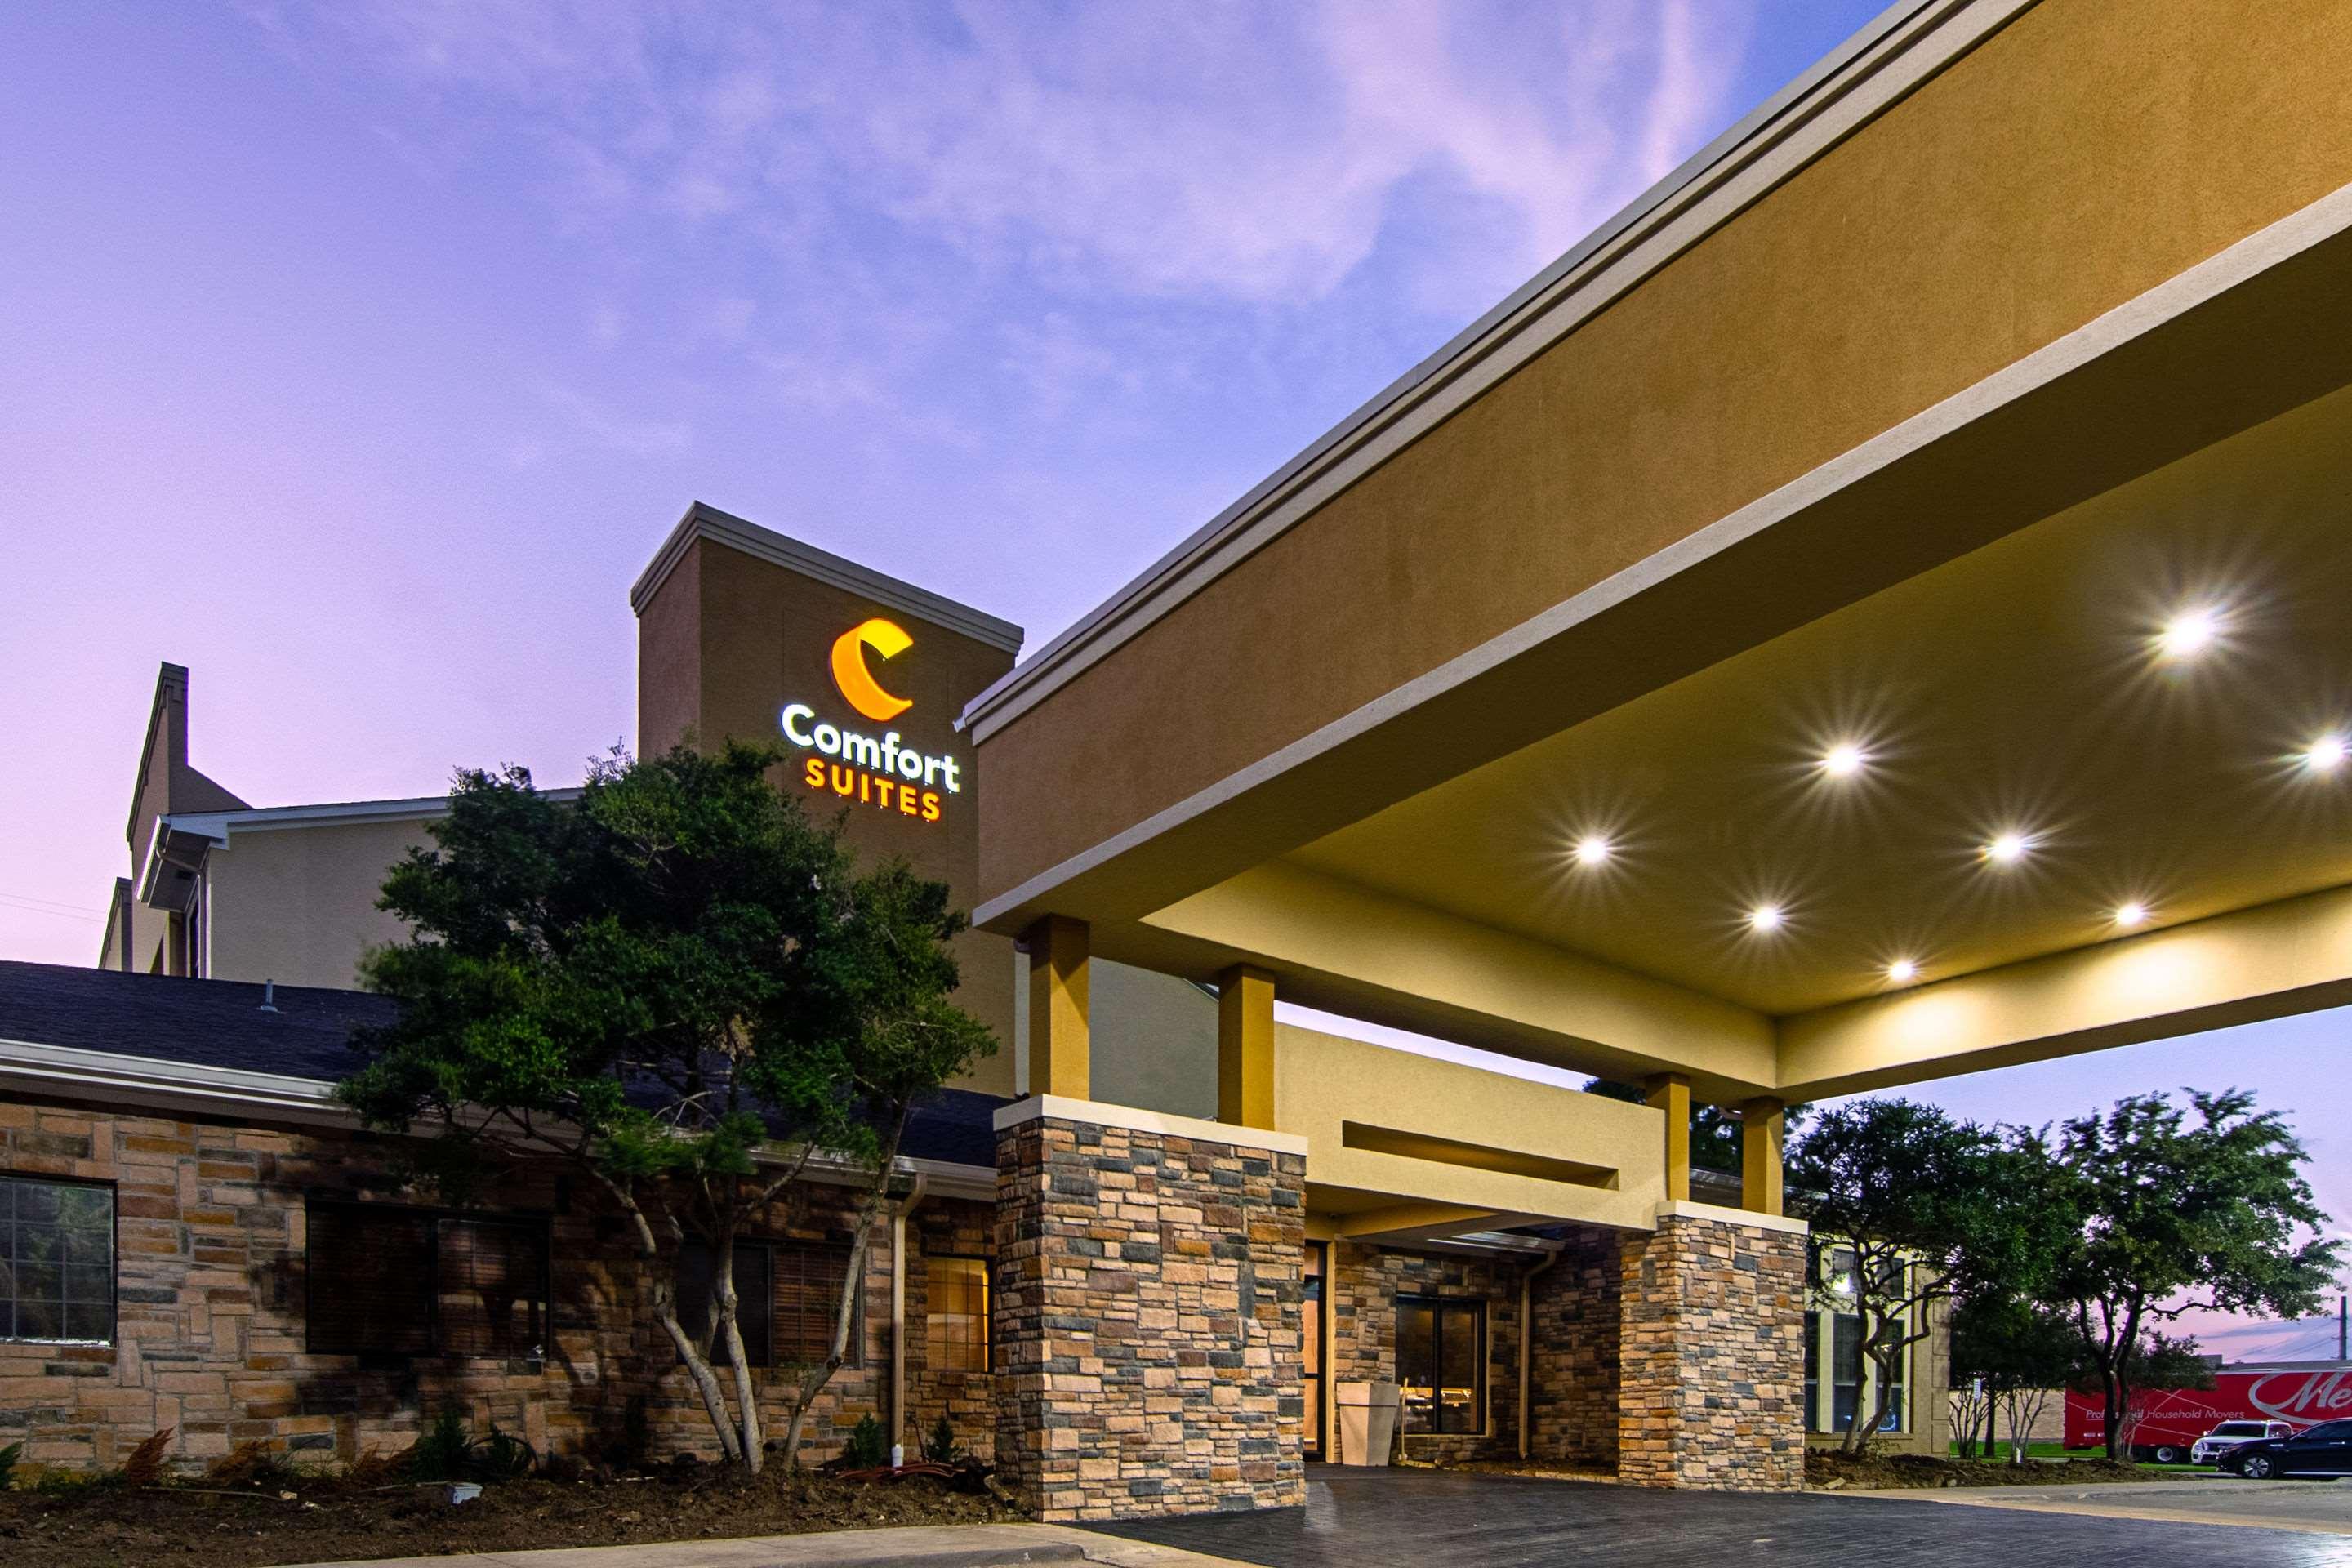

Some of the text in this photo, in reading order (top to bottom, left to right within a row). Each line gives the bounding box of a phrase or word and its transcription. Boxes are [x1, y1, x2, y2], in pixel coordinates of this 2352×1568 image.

[782, 704, 960, 792] Comfort
[805, 758, 940, 821] SUITES
[2147, 1409, 2202, 1419] Household
[2205, 1410, 2245, 1419] Movers
